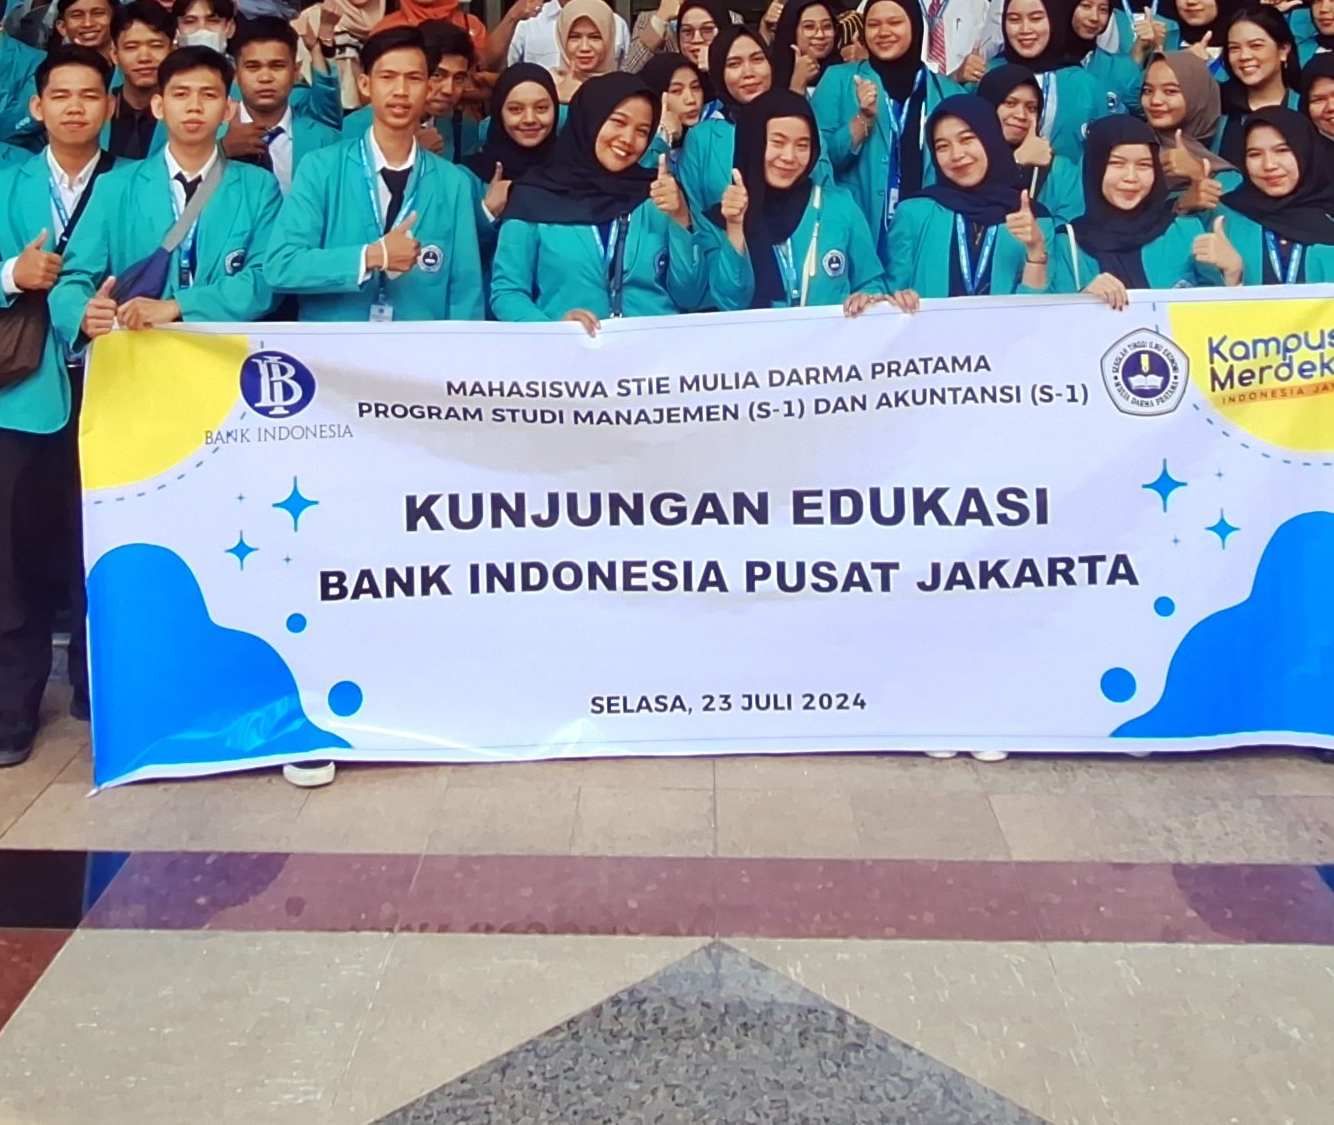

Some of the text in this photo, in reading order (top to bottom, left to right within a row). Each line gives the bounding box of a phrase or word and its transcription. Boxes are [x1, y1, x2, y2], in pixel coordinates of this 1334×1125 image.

[446, 354, 992, 399] MAHASISWA STIE MULIA DARMA PRATAMA
[1222, 387, 1305, 405] INDONESIA
[357, 383, 1089, 426] PROGRAM STUDI MANAJEMEN (S-1) DAN AKUNTANSI (S-1)
[205, 423, 354, 445] BANK INDONESIA
[405, 486, 1049, 532] KUNJUNGAN EDUKASI
[319, 553, 1140, 602] BANK INDONESIA PUSAT JAKARTA
[590, 692, 867, 715] SELASA, 23 JULI 2024
